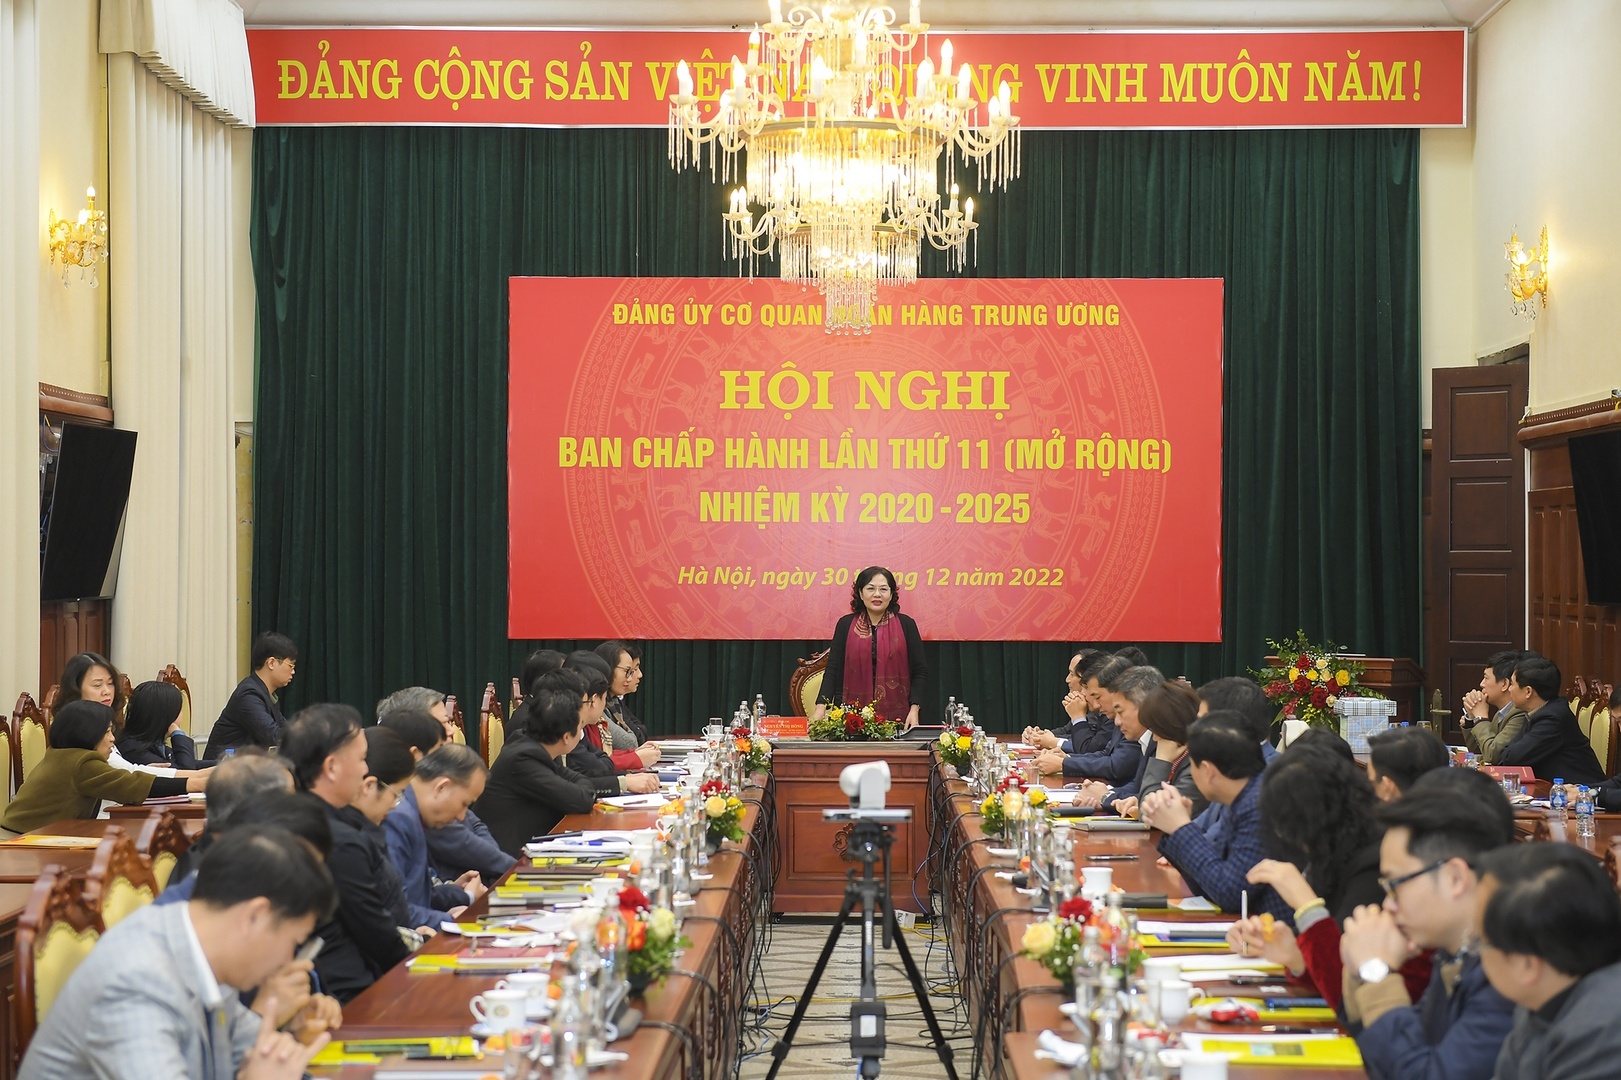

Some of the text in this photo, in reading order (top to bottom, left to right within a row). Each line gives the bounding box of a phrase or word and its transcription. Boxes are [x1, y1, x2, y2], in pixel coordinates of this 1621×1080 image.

[278, 39, 402, 100] ĐẢNG
[414, 46, 534, 111] CỘNG
[545, 41, 632, 101] SẢN
[1034, 63, 1148, 102] VINH
[1159, 48, 1292, 103] MUÔN
[612, 297, 675, 326] ĐẢNG
[684, 297, 714, 326] ỦY
[721, 301, 753, 326] CƠ
[760, 304, 823, 328] QUAN
[901, 299, 963, 326] HÀNG
[971, 304, 1047, 326] TRUNG
[1056, 302, 1120, 327] ƯƠNG
[719, 360, 1011, 420] HỘI NGHỊ
[559, 426, 1172, 477] BAN CHẤP HÀNH LẦN THỨ 11 (MỞ RỘNG)
[699, 485, 800, 529] NHIỆM
[811, 486, 849, 523] KỲ
[860, 493, 933, 523] 2020
[956, 493, 1030, 524] 2025
[678, 565, 709, 585] Hà
[713, 566, 756, 590] Nội,
[762, 566, 817, 591] ngày
[821, 567, 849, 586] 30
[926, 568, 950, 586] 12
[955, 567, 1004, 586] năm
[1009, 567, 1064, 586] 2022
